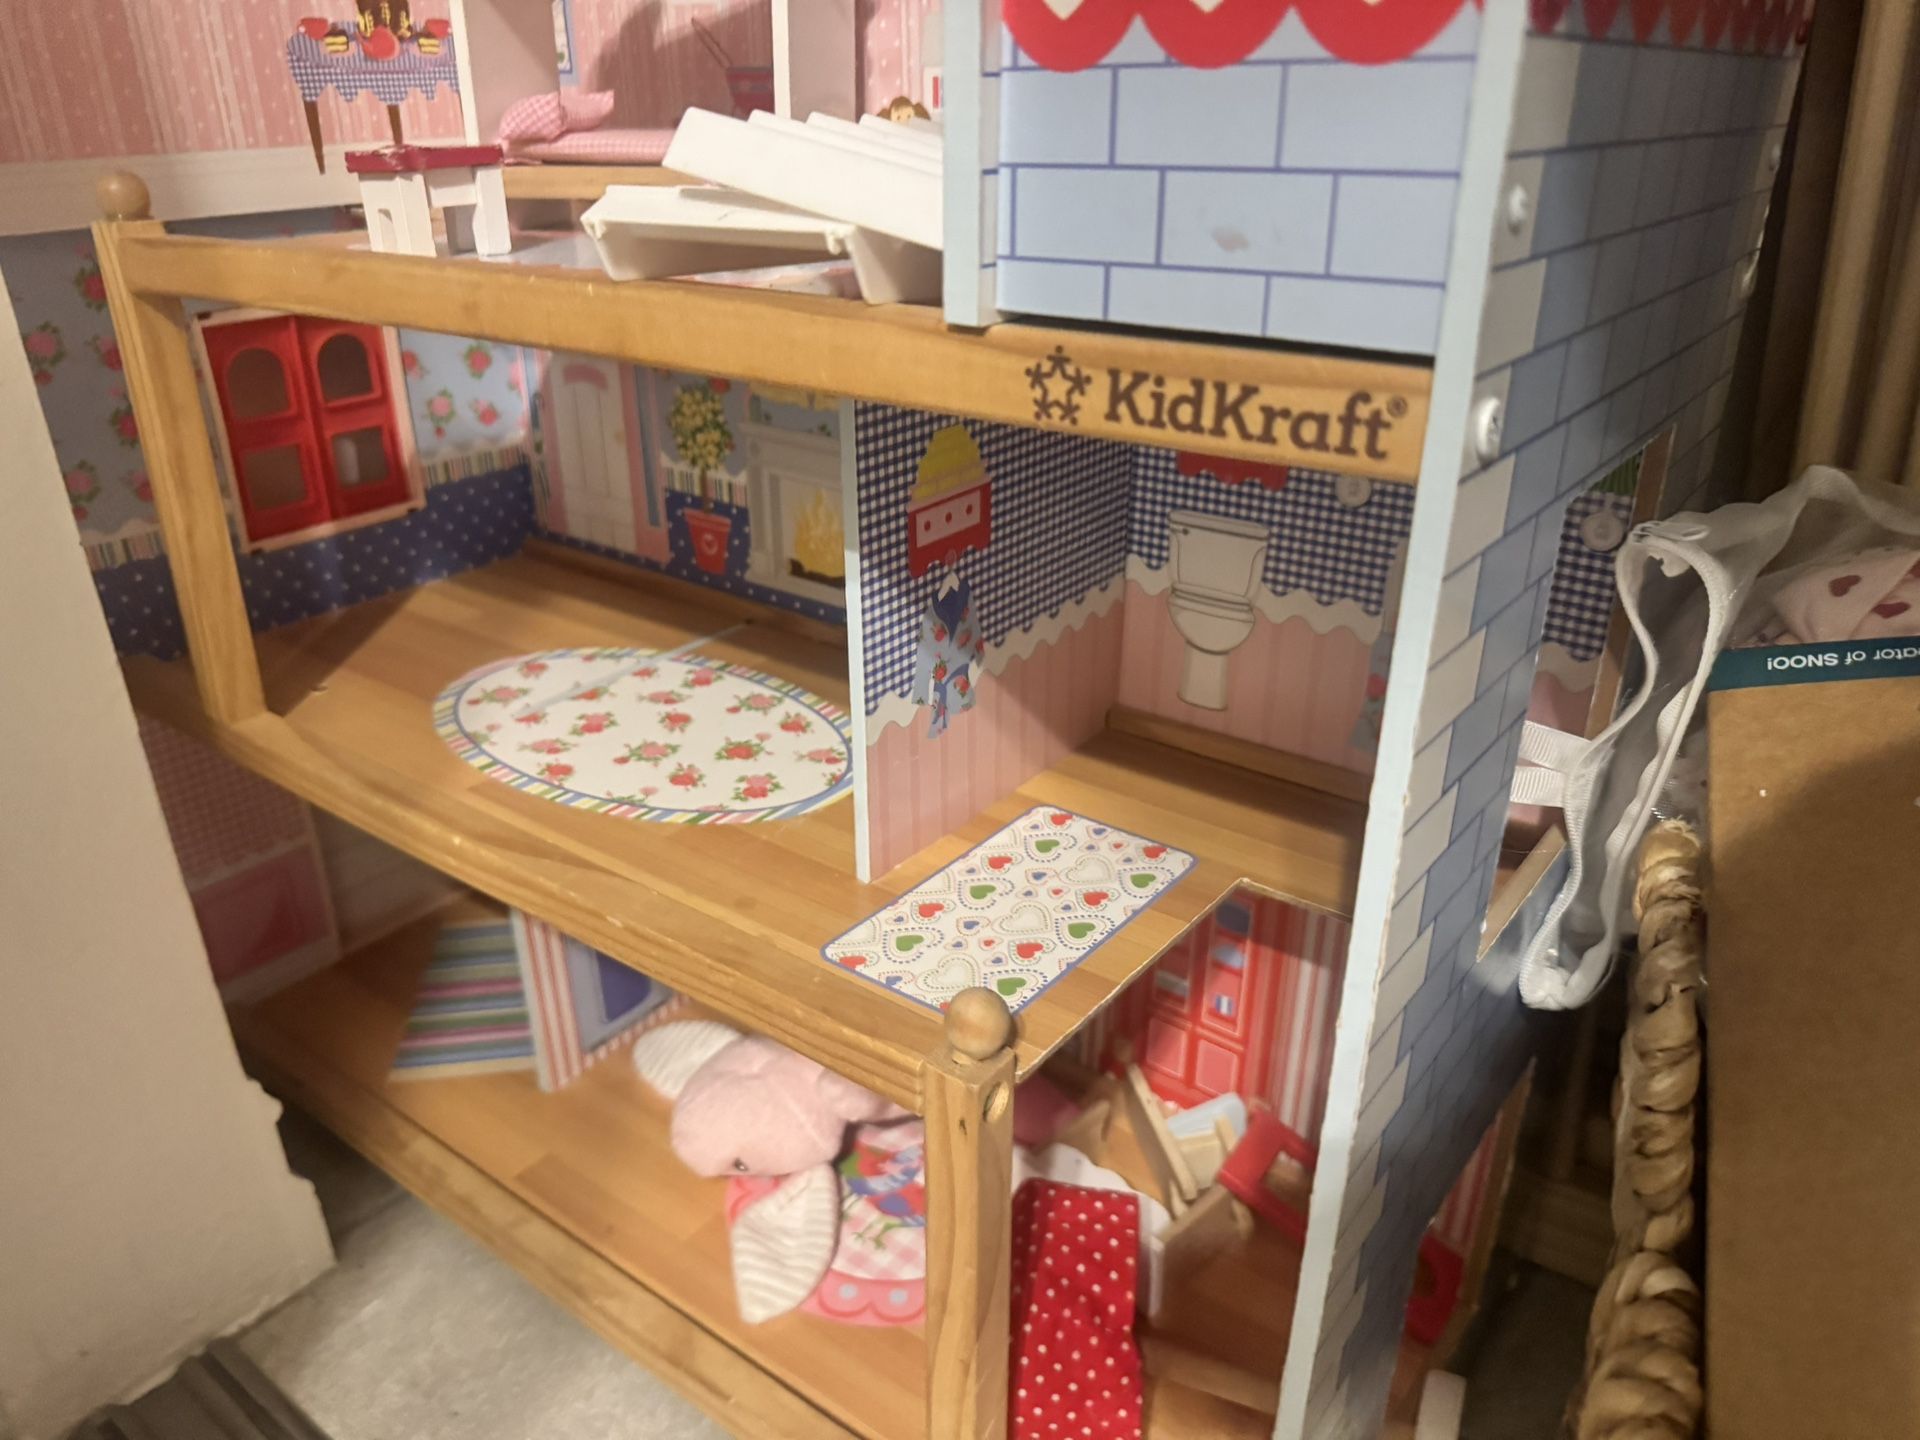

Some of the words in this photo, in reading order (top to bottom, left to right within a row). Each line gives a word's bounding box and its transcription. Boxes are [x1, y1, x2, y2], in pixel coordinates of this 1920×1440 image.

[1844, 651, 1867, 664] of
[1873, 647, 1920, 660] ator
[1767, 653, 1838, 670] SNOO!
